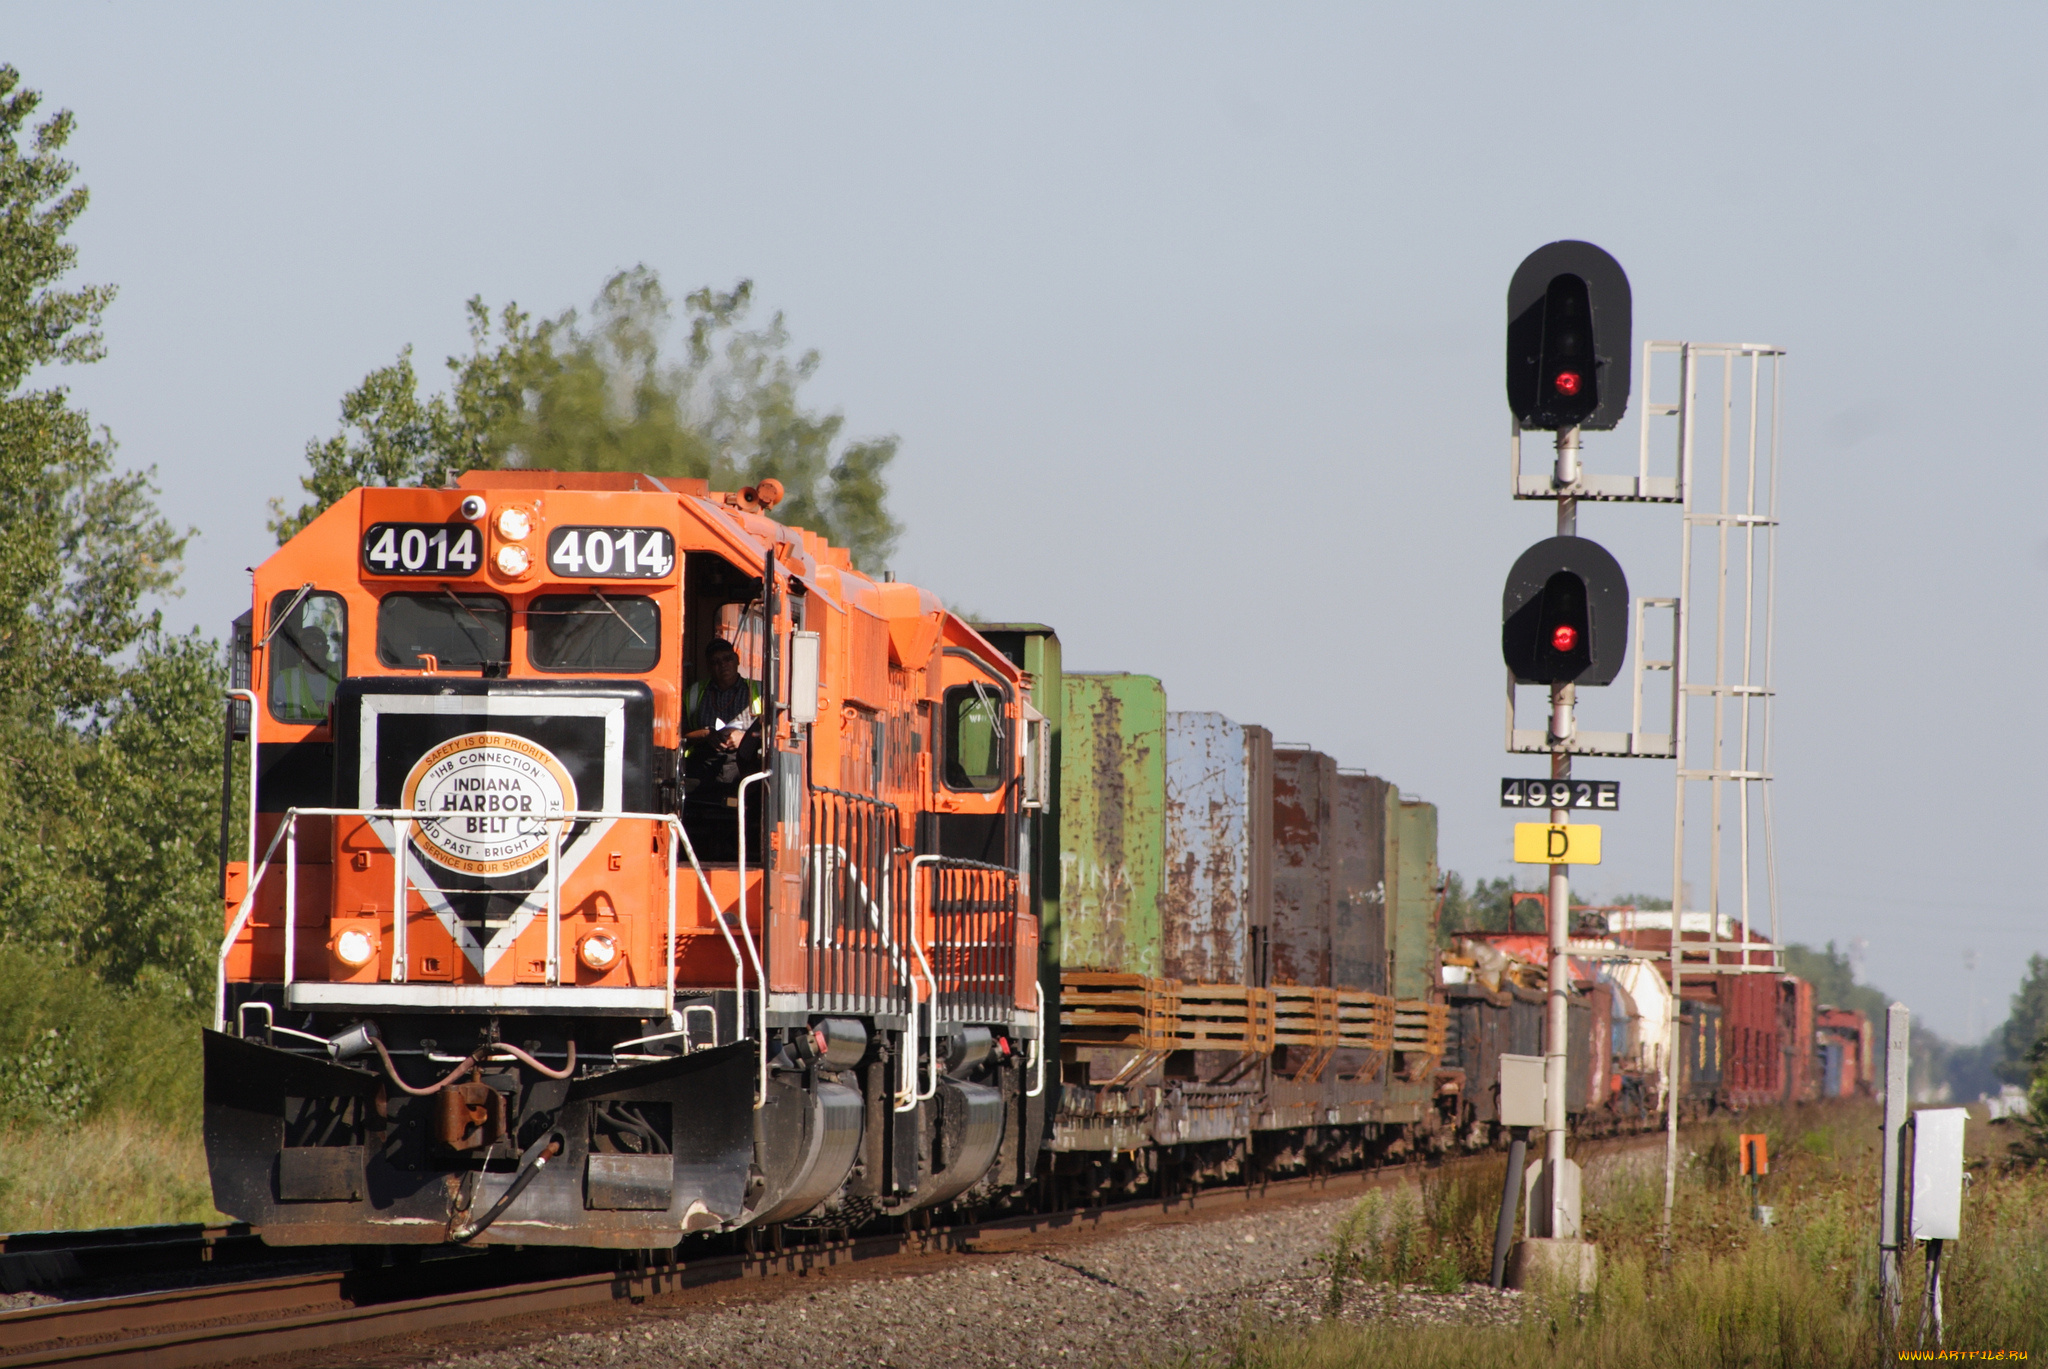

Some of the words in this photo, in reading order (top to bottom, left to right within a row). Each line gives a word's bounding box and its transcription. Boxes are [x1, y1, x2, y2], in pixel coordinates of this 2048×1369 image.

[369, 528, 476, 570] 4014
[553, 531, 667, 573] 4014
[425, 740, 461, 766] SAFETY
[464, 737, 475, 747] IS
[478, 736, 500, 745] OUR
[505, 739, 552, 765] PRIORITY
[454, 778, 522, 791] INDIANA
[1504, 782, 1616, 807] 4992E
[444, 795, 532, 811] HARBOR
[466, 816, 509, 833] BELT
[422, 841, 460, 869] SERVICE
[463, 862, 474, 872] IS
[477, 864, 499, 872] OUR
[444, 838, 471, 856] PAST
[485, 839, 529, 857] BRIGHT
[1547, 829, 1568, 858] D
